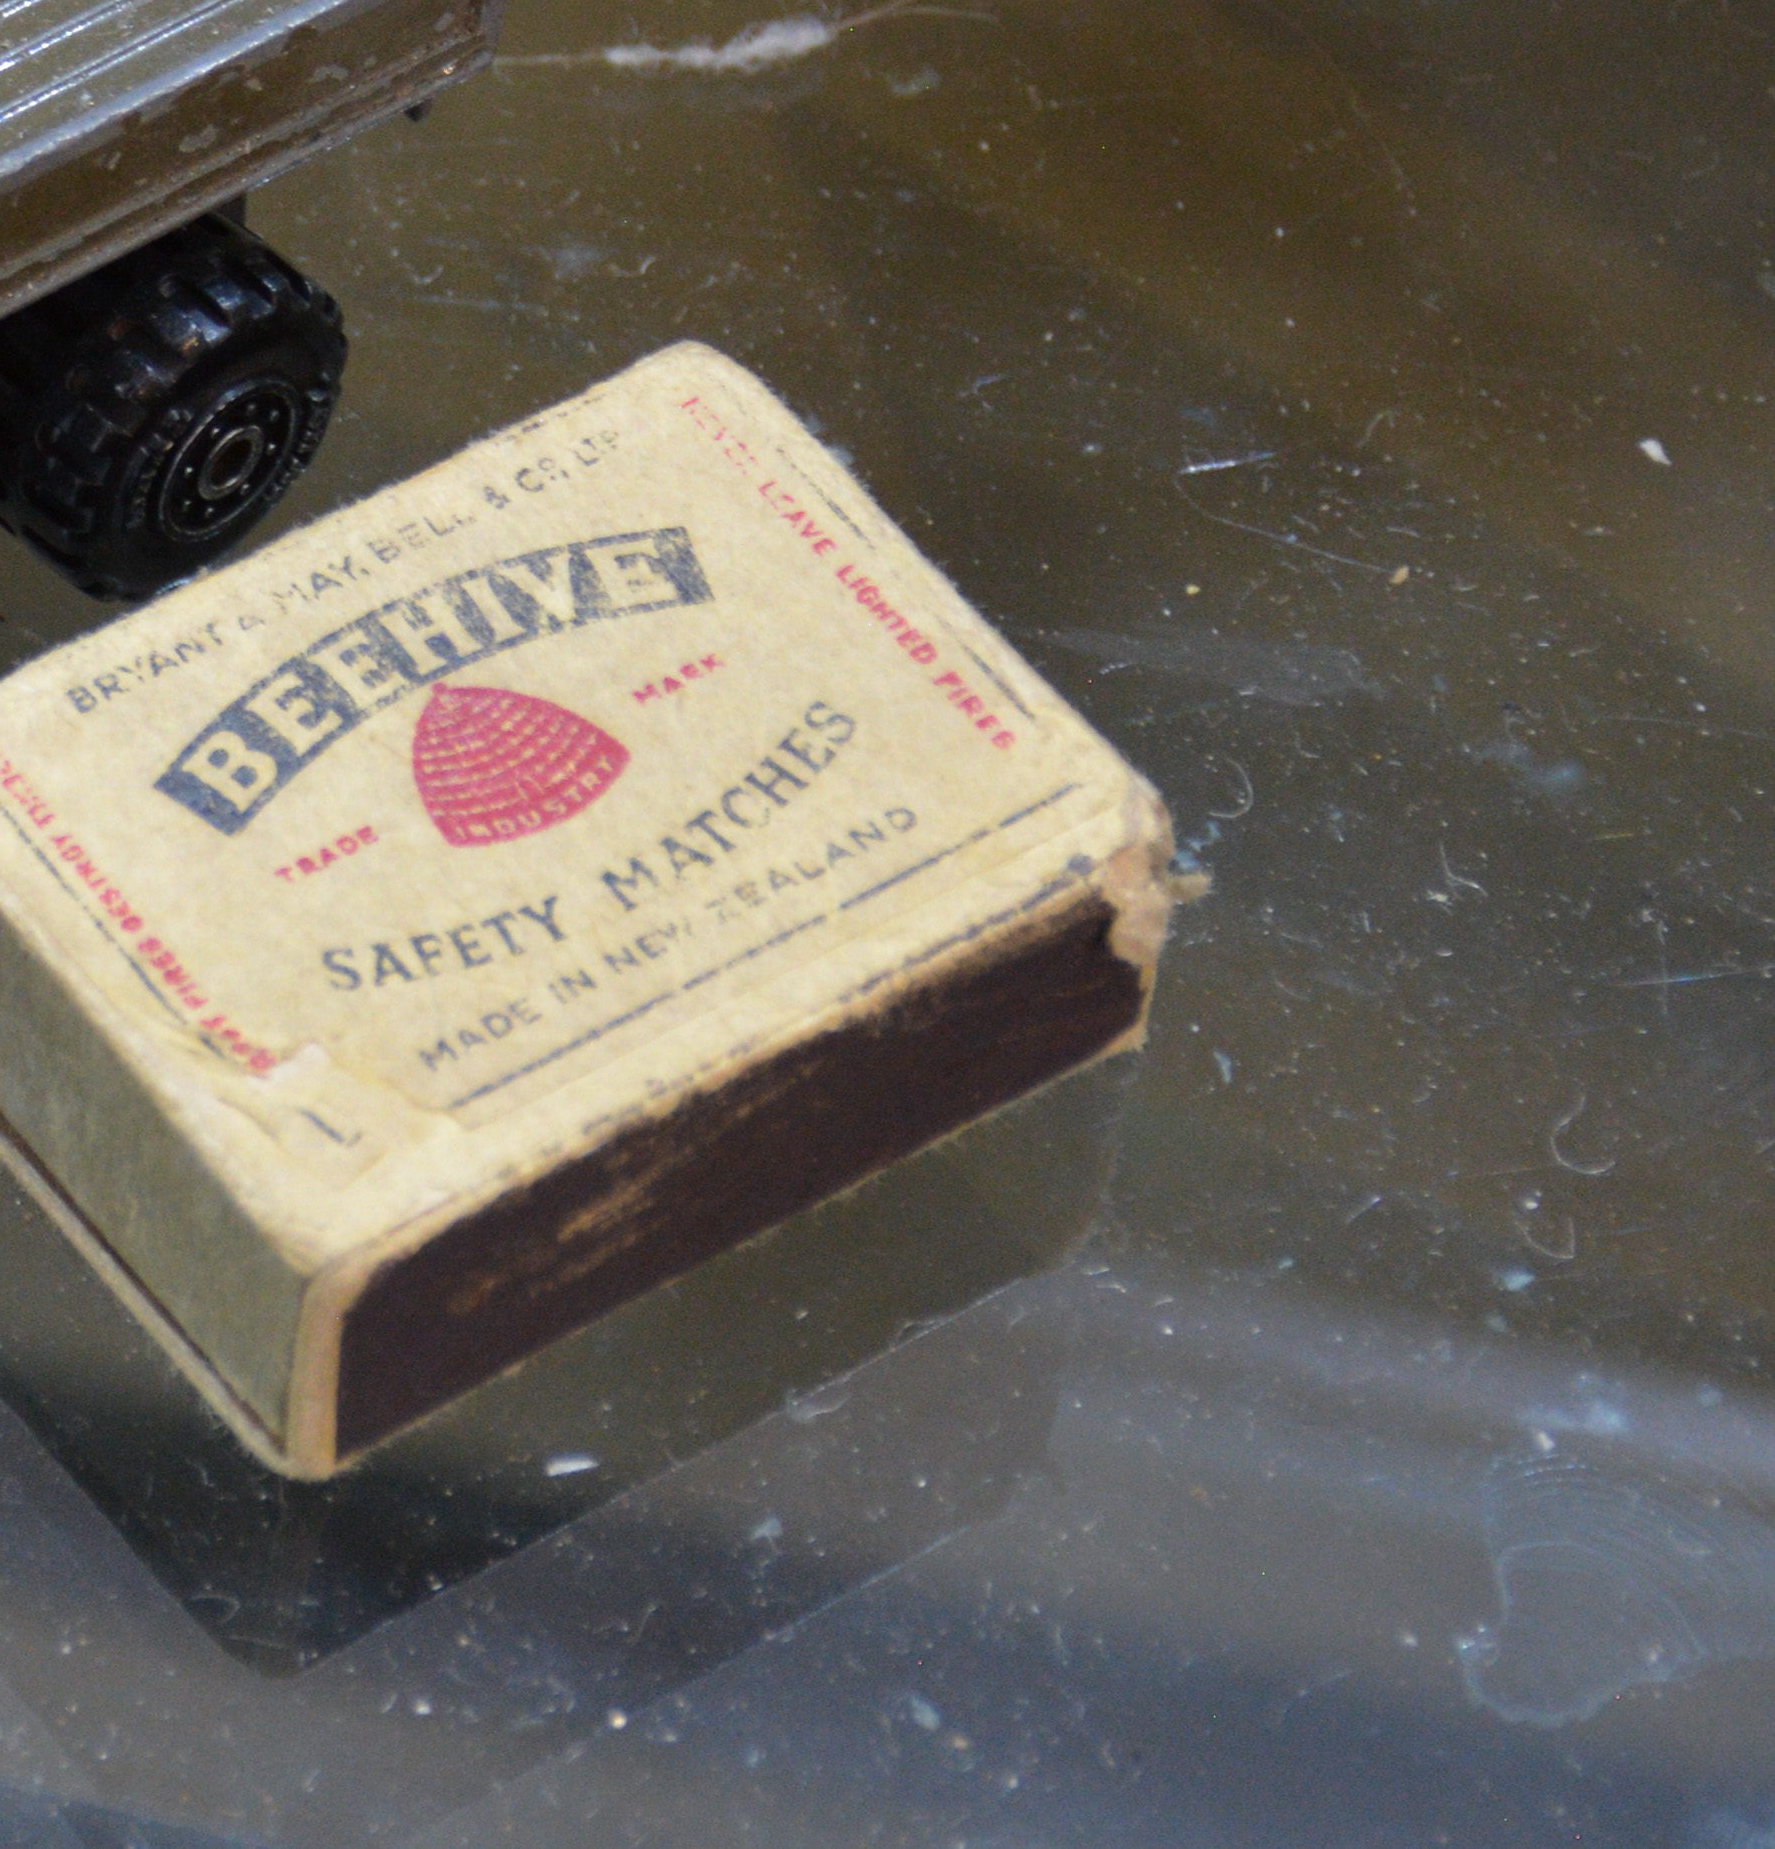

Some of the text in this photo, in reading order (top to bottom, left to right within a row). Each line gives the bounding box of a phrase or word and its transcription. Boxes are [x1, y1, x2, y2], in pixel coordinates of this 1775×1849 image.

[66, 621, 224, 714] BRYANT
[366, 513, 476, 565] BELL
[835, 564, 939, 665] LIGHTED
[175, 536, 690, 823] BEEHIVE
[631, 652, 727, 705] MARK
[320, 699, 858, 992] SAFETY MATCHES
[453, 755, 617, 842] INDUSTRY
[50, 833, 146, 933] DESTROY
[273, 824, 380, 884] TRADE
[417, 806, 918, 1073] MADE IN NEW ZEALAND
